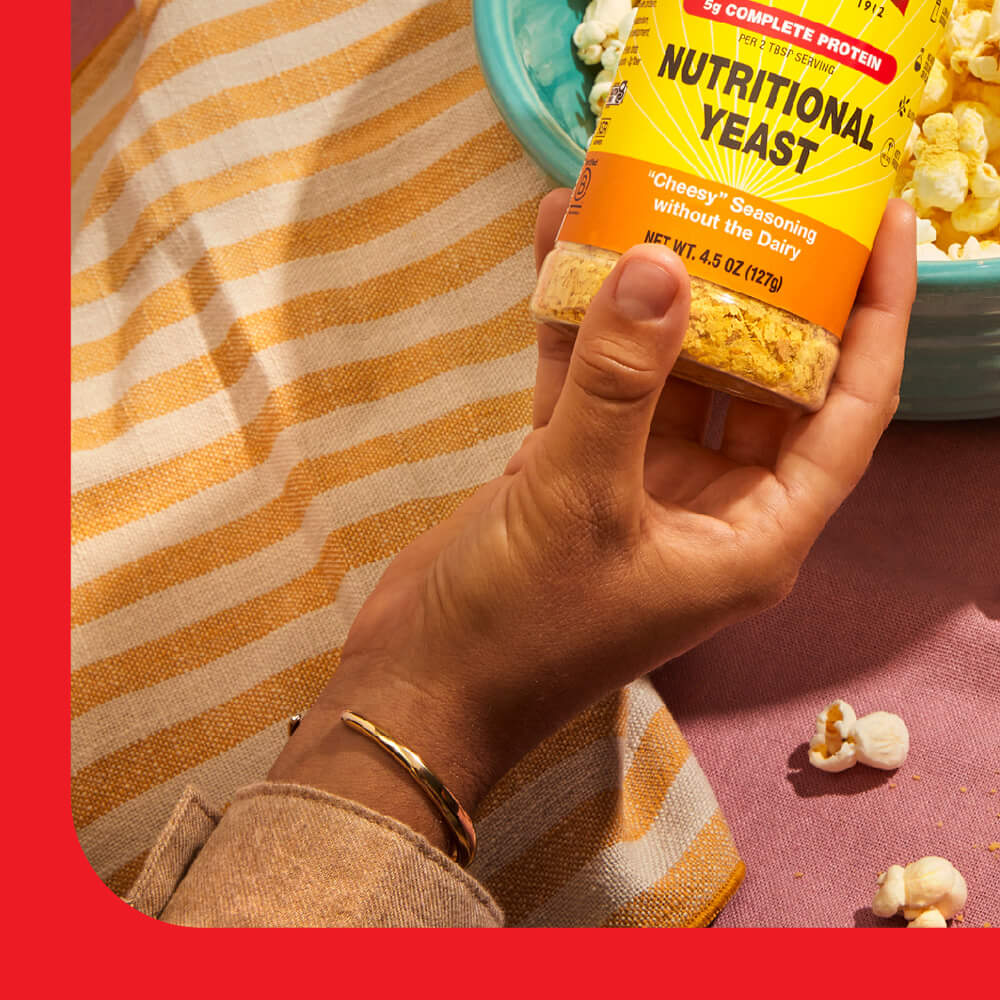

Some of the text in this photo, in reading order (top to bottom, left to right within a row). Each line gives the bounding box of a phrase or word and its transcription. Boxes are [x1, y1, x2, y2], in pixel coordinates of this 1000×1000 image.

[725, 3, 815, 42] COMPLETE
[817, 32, 883, 72] PROTEIN
[738, 33, 837, 76] PER 2 TBSP SERVING
[657, 43, 875, 151] NUTRITIONAL
[700, 103, 820, 175] YEAST
[648, 169, 818, 245] “Cheesy” Seasoning
[653, 198, 802, 262] without the Dairy
[672, 239, 696, 261] WT.
[699, 249, 722, 268] 4.5
[724, 257, 745, 277] OZ
[745, 264, 783, 293] (127g)
